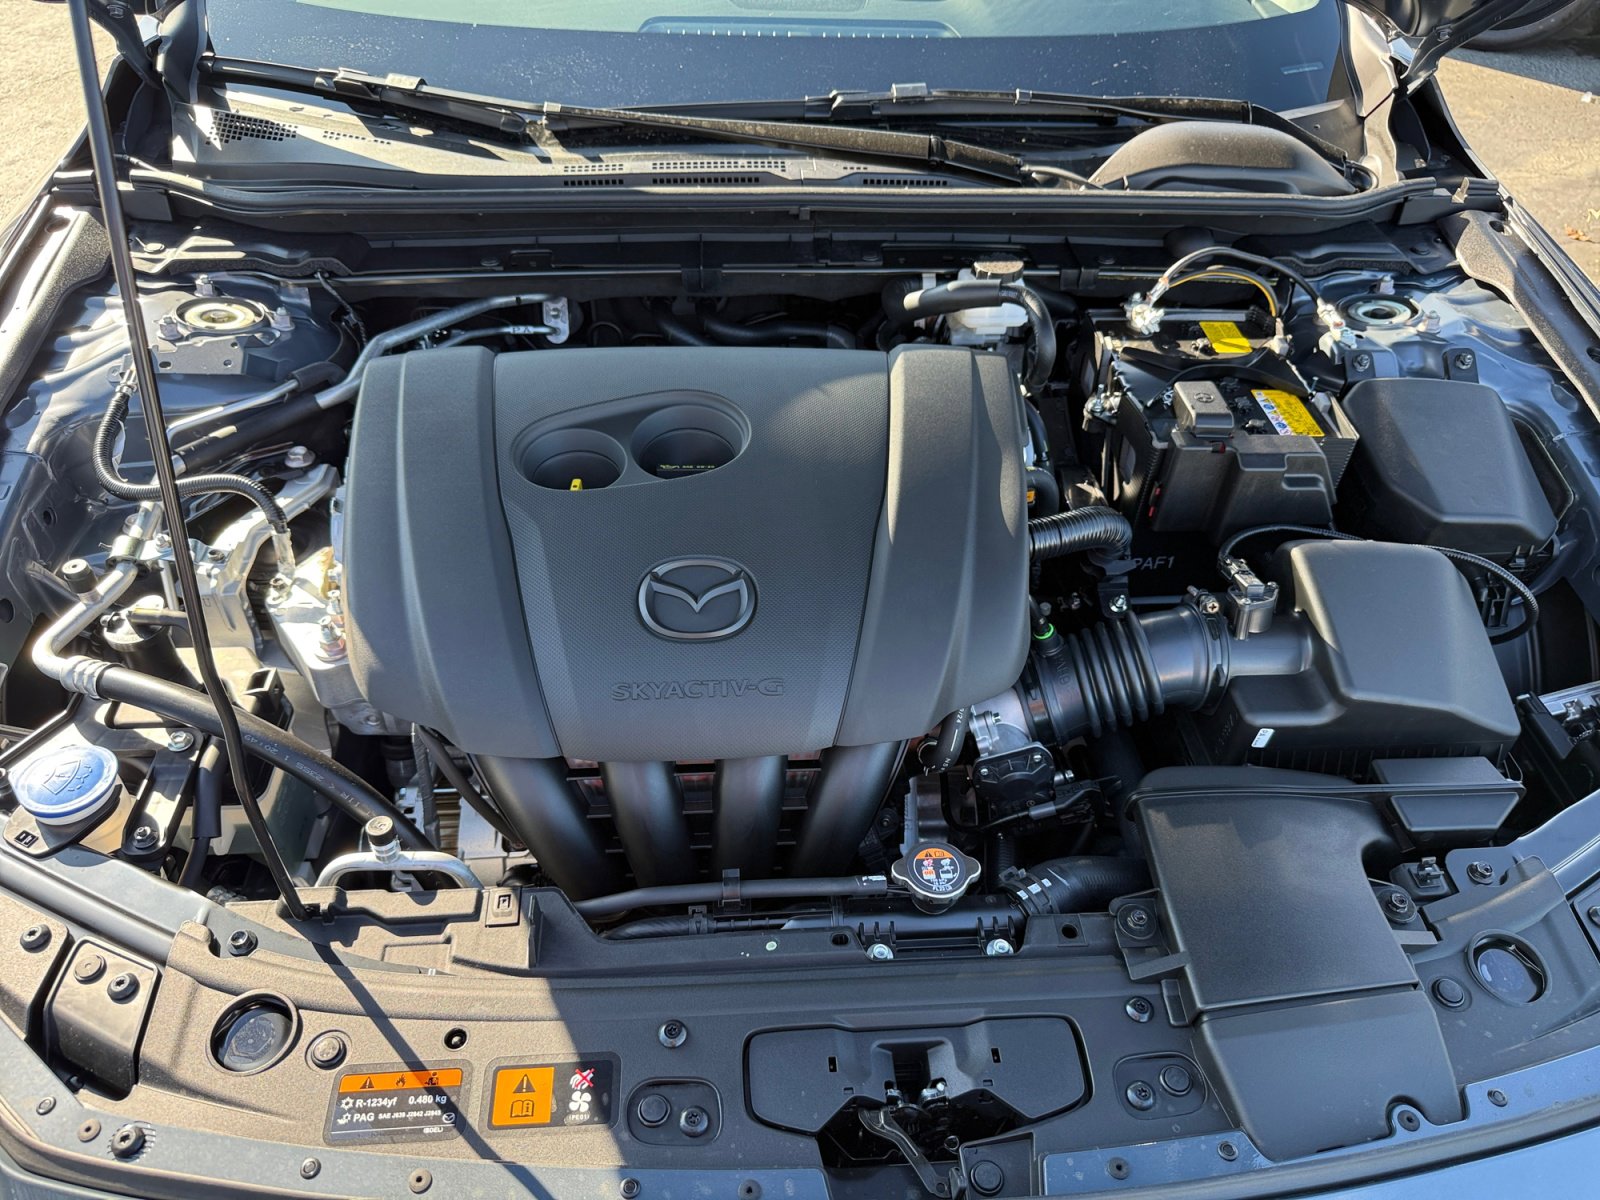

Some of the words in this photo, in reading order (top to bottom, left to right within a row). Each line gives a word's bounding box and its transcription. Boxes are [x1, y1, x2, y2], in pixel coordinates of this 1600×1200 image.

[611, 678, 784, 700] SKYACTIV-G
[355, 1096, 397, 1109] R-1234yf
[408, 1095, 434, 1105] 0.480
[435, 1094, 447, 1105] kg
[353, 1113, 375, 1122] PAG
